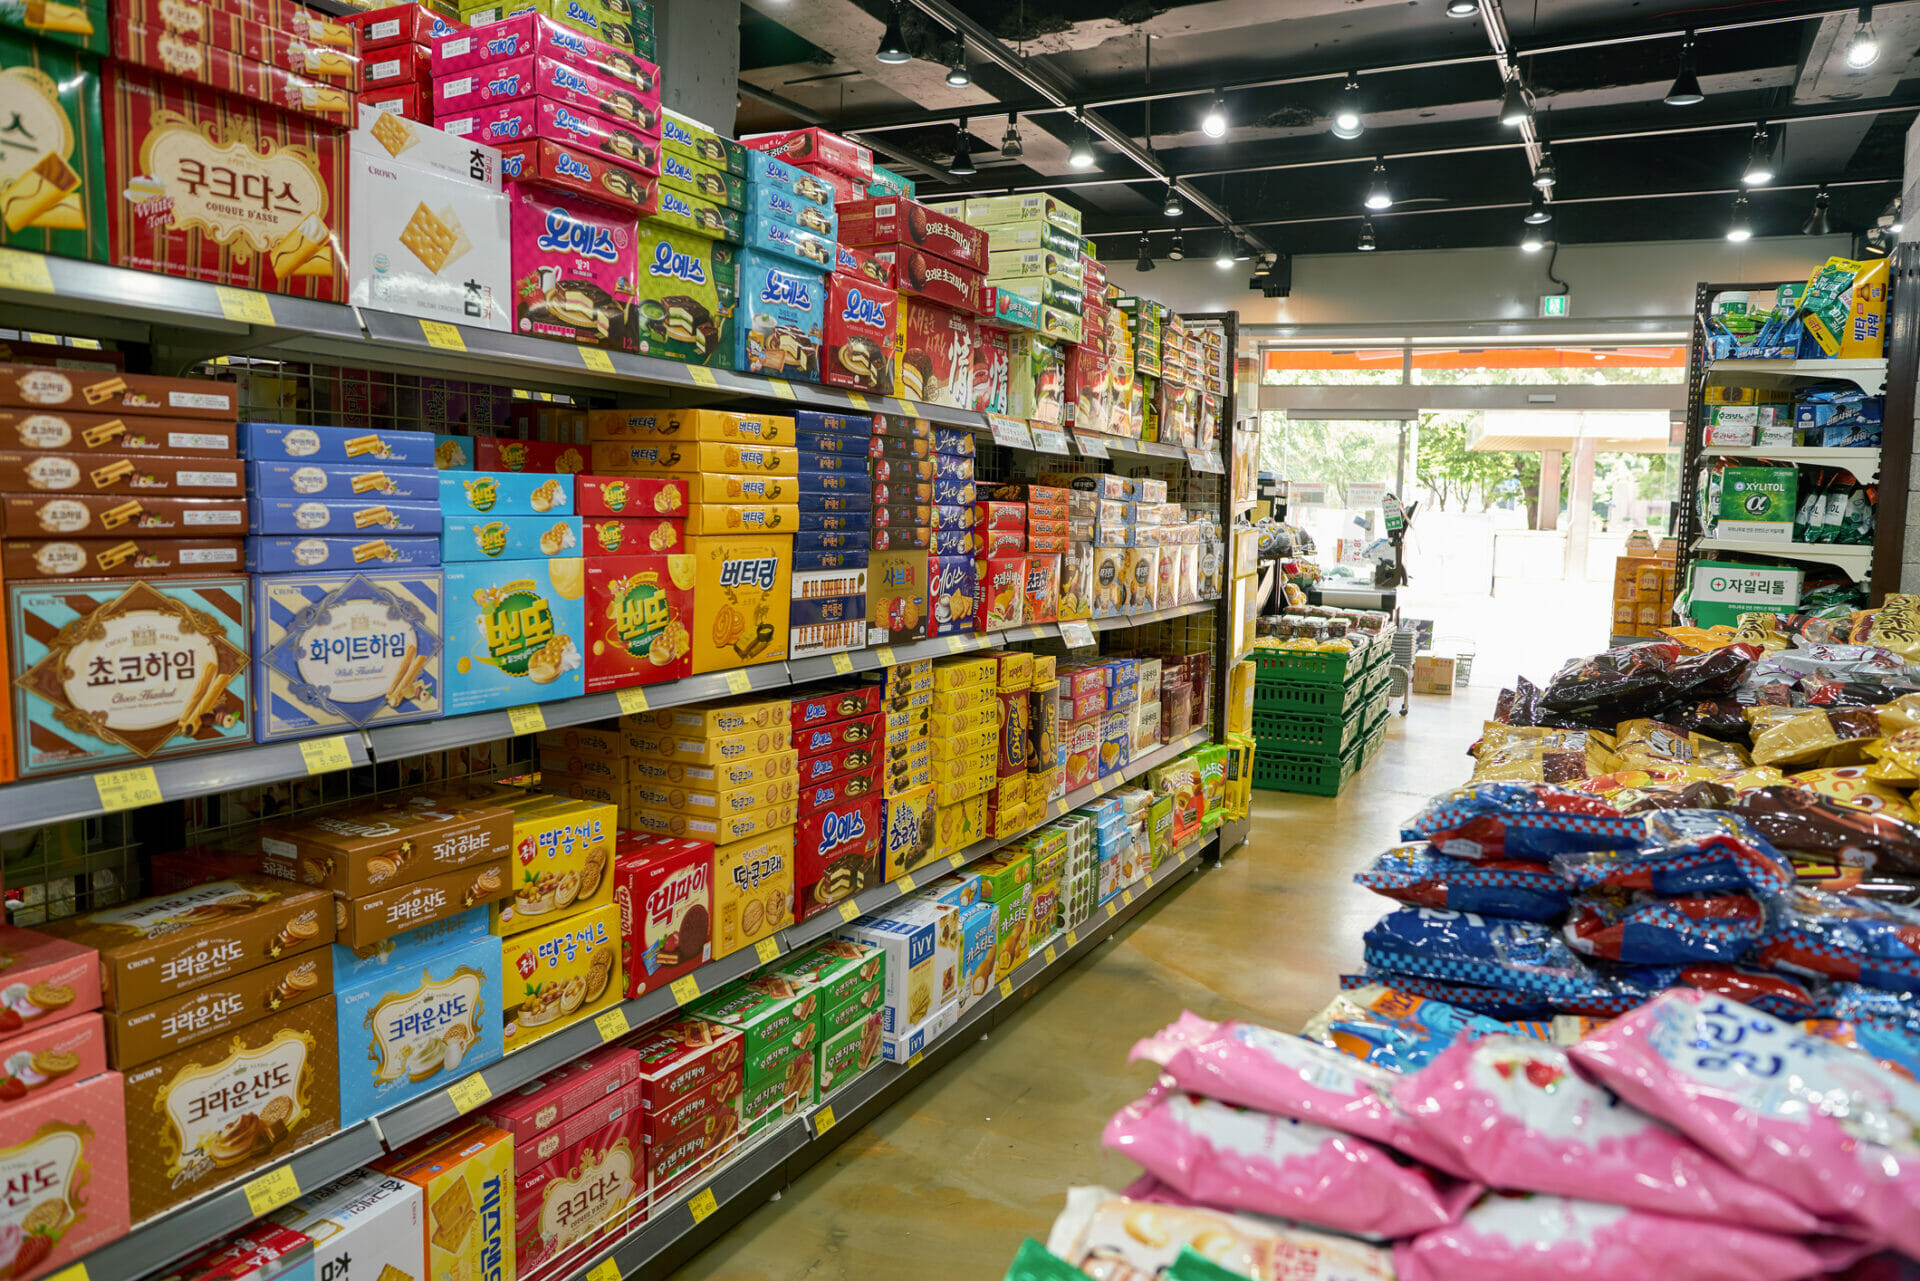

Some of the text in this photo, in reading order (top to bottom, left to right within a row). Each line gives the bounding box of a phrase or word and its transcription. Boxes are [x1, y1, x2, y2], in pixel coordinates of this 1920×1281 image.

[566, 1, 598, 28] 오예스
[551, 30, 587, 55] 오예스
[552, 67, 588, 94] 오예스
[554, 108, 590, 135] 오예스
[663, 120, 693, 147] 오예스
[368, 165, 397, 181] CROWN
[554, 153, 591, 181] 오예스
[663, 157, 693, 182] 오예스
[765, 161, 790, 185] 오예스
[178, 157, 303, 216] 쿠크다스
[134, 196, 175, 219] White
[206, 201, 279, 223] COUQUE D'ASSE
[661, 193, 691, 218] 오예스
[767, 193, 793, 215] 오예스
[538, 208, 618, 263] 오예스
[767, 224, 792, 246] 오예스
[925, 222, 970, 253] 오리온 초코파이
[649, 240, 707, 286] 오예스
[838, 249, 858, 269] 오예스
[761, 267, 812, 312] 오예스
[925, 268, 969, 302] 오리온 초코파이
[842, 288, 886, 329] 오예스
[738, 420, 762, 436] 버터링
[740, 451, 764, 466] 버터링
[742, 481, 765, 496] 버터링
[1745, 481, 1785, 492] XYLITOL
[742, 511, 765, 525] 버터링
[720, 557, 779, 591] 버터링
[883, 566, 915, 587] 사브레
[930, 563, 967, 597] 에이스
[1728, 578, 1785, 595] 자일리톨
[310, 632, 406, 664] 화이트하임
[87, 649, 195, 688] 초코하임
[804, 703, 826, 722] 오예스
[810, 731, 833, 750] 오예스
[811, 760, 834, 779] 오예스
[813, 788, 835, 806] 오예스
[539, 820, 605, 858] 땅콩샌드
[817, 810, 866, 855] 오예스
[889, 816, 920, 852] 초코칩
[386, 889, 447, 924] 크라운산도
[646, 862, 709, 928] 빅파이
[538, 922, 609, 968] 땅콩샌드
[911, 932, 934, 960] IVY
[127, 955, 156, 971] CROWN
[160, 939, 245, 984] 크라운산도
[345, 991, 370, 1005] CROWN
[128, 1012, 156, 1028] CROWN
[160, 993, 245, 1039] 크라운산도
[389, 995, 468, 1042] 크라운산도
[911, 1033, 924, 1051] IVY
[128, 1066, 163, 1084] CROWN
[187, 1063, 293, 1125] 크라운산도
[525, 1173, 545, 1189] CROWN
[556, 1170, 621, 1228] 쿠크다스
